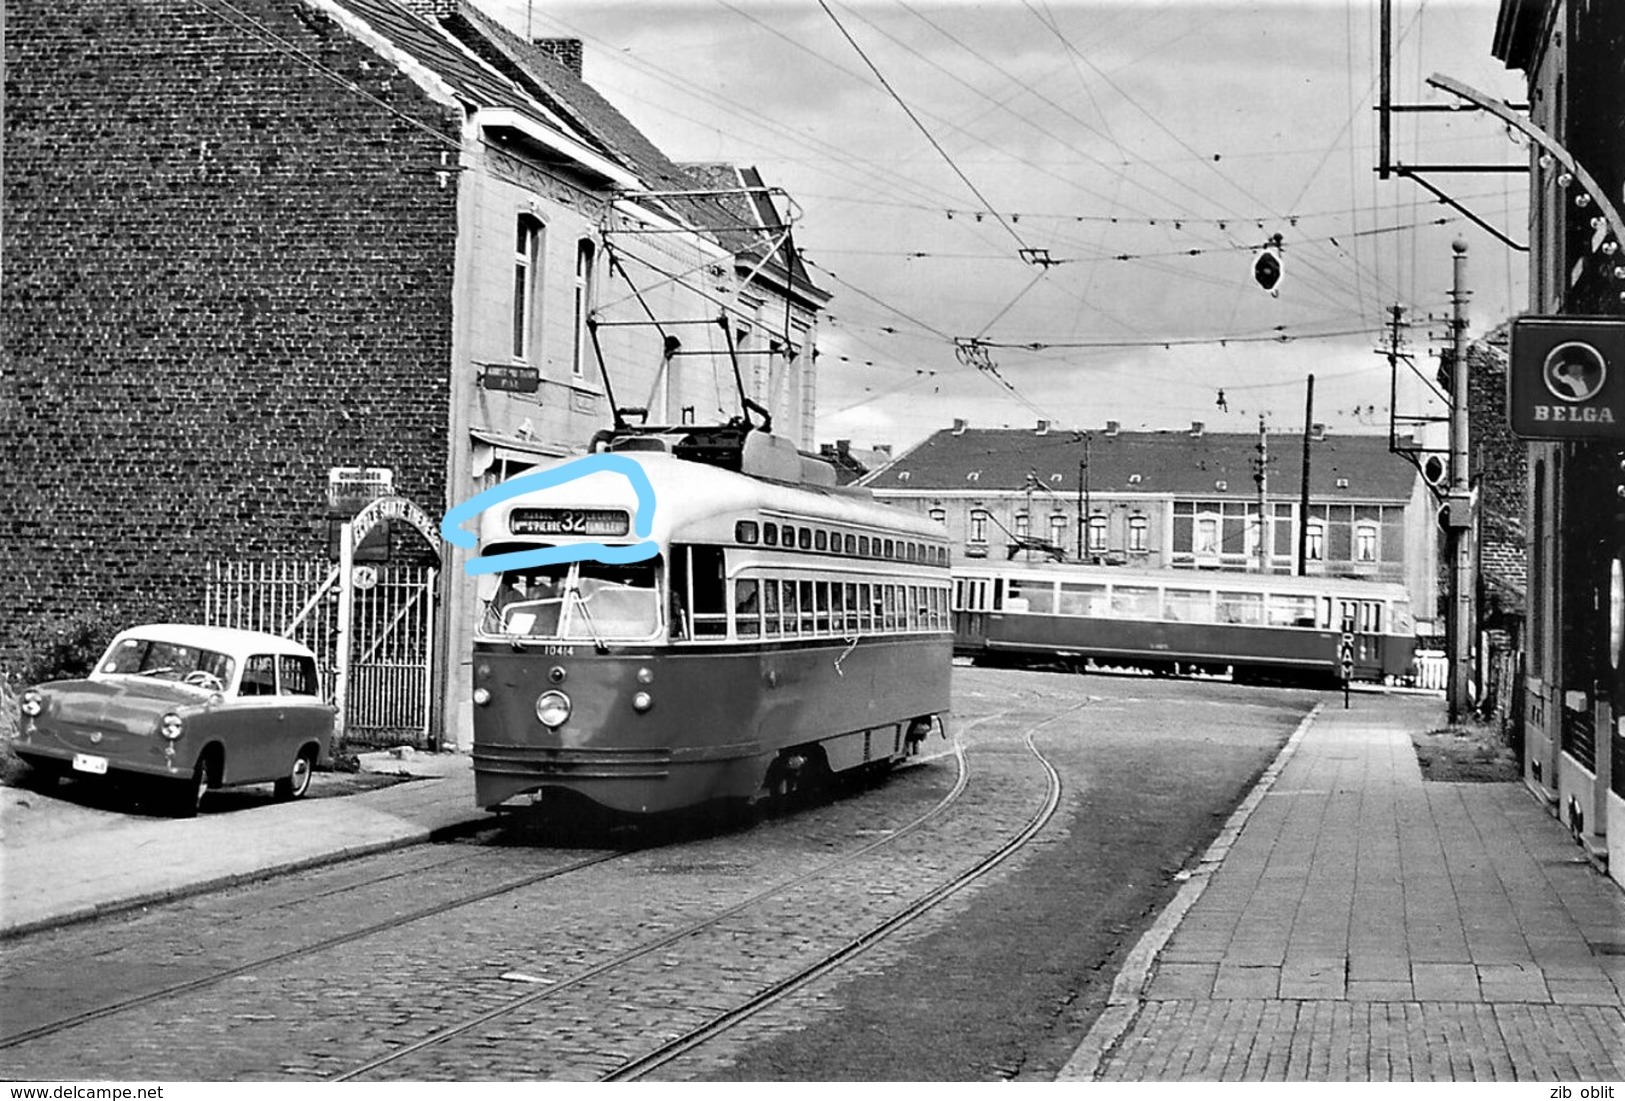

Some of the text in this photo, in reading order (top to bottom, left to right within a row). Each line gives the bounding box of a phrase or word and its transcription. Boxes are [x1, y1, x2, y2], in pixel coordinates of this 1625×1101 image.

[1534, 405, 1615, 423] BELGA
[561, 511, 585, 531] 32
[544, 646, 574, 656] 10414
[1342, 617, 1355, 679] TRAM
